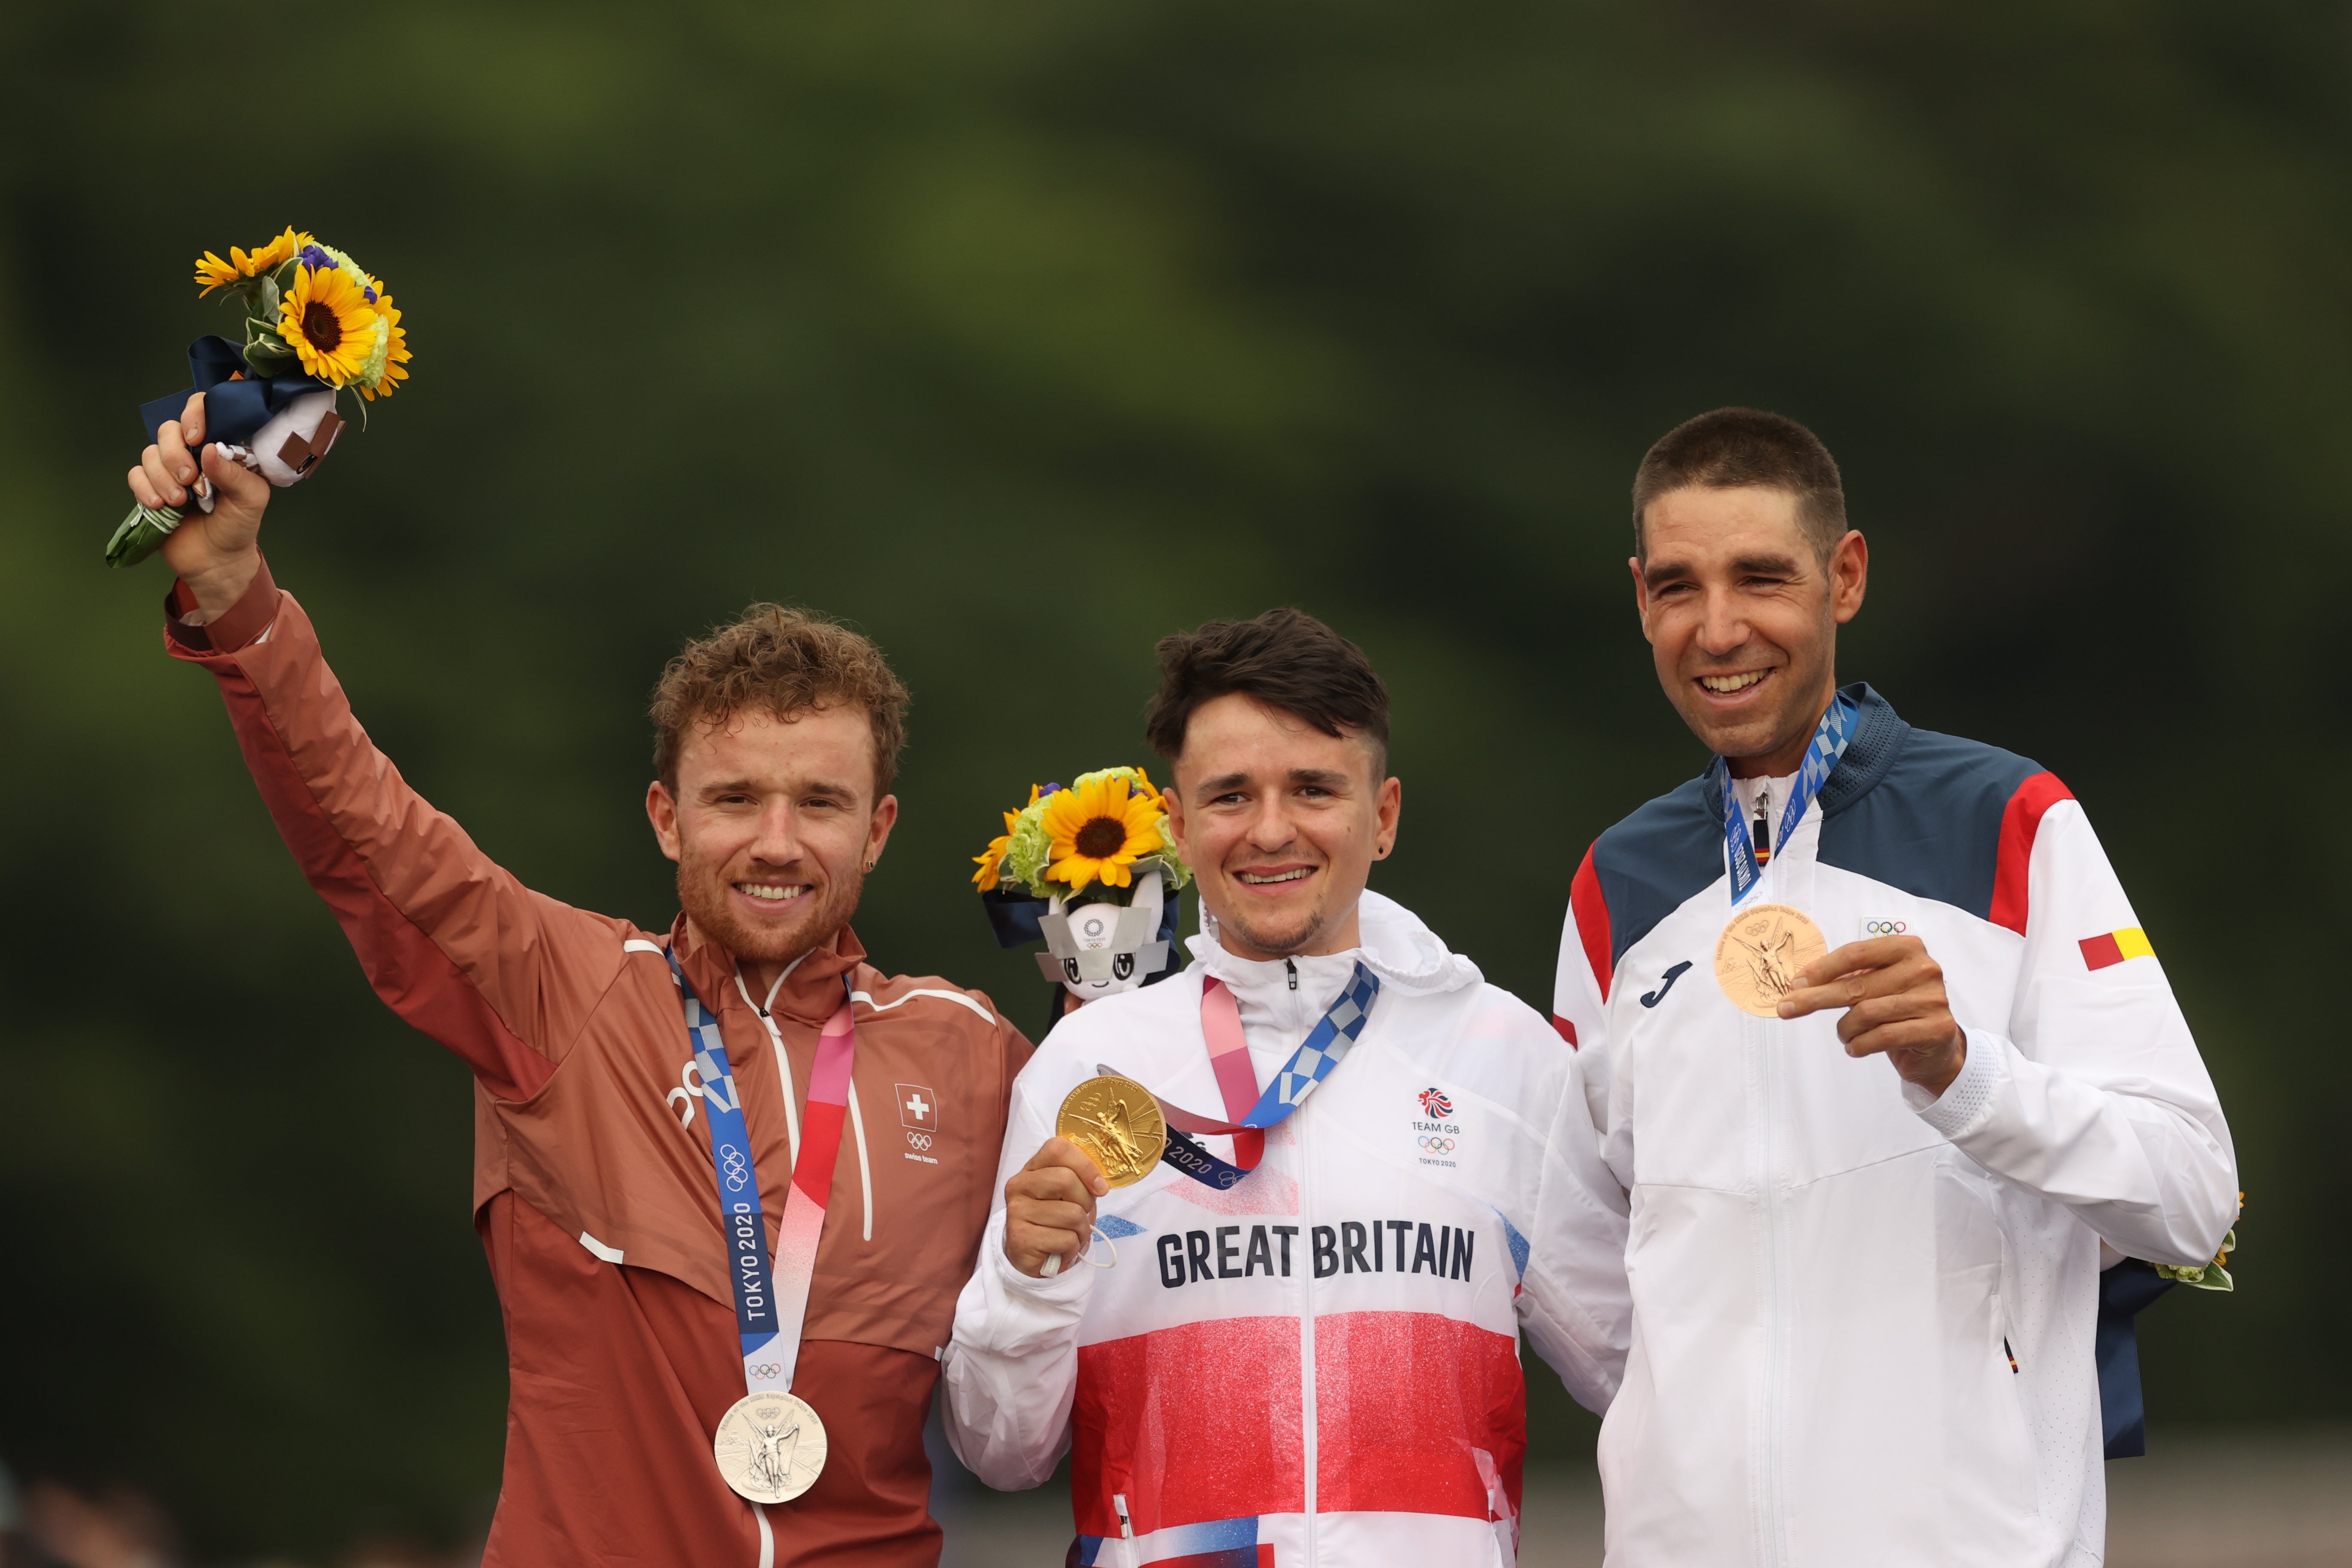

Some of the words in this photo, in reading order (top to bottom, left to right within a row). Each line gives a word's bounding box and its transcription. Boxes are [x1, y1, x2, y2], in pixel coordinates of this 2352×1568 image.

[1412, 1122, 1441, 1132] TEAM
[1444, 1124, 1460, 1134] GB
[904, 1152, 922, 1161] swiss
[922, 1155, 938, 1164] team
[1168, 1146, 1213, 1174] 2020
[1419, 1158, 1439, 1166] TOKYO
[733, 1203, 756, 1250] 2020
[1157, 1225, 1299, 1289] GREAT
[1312, 1220, 1475, 1283] BRITAIN
[740, 1256, 766, 1321] TOKYO
